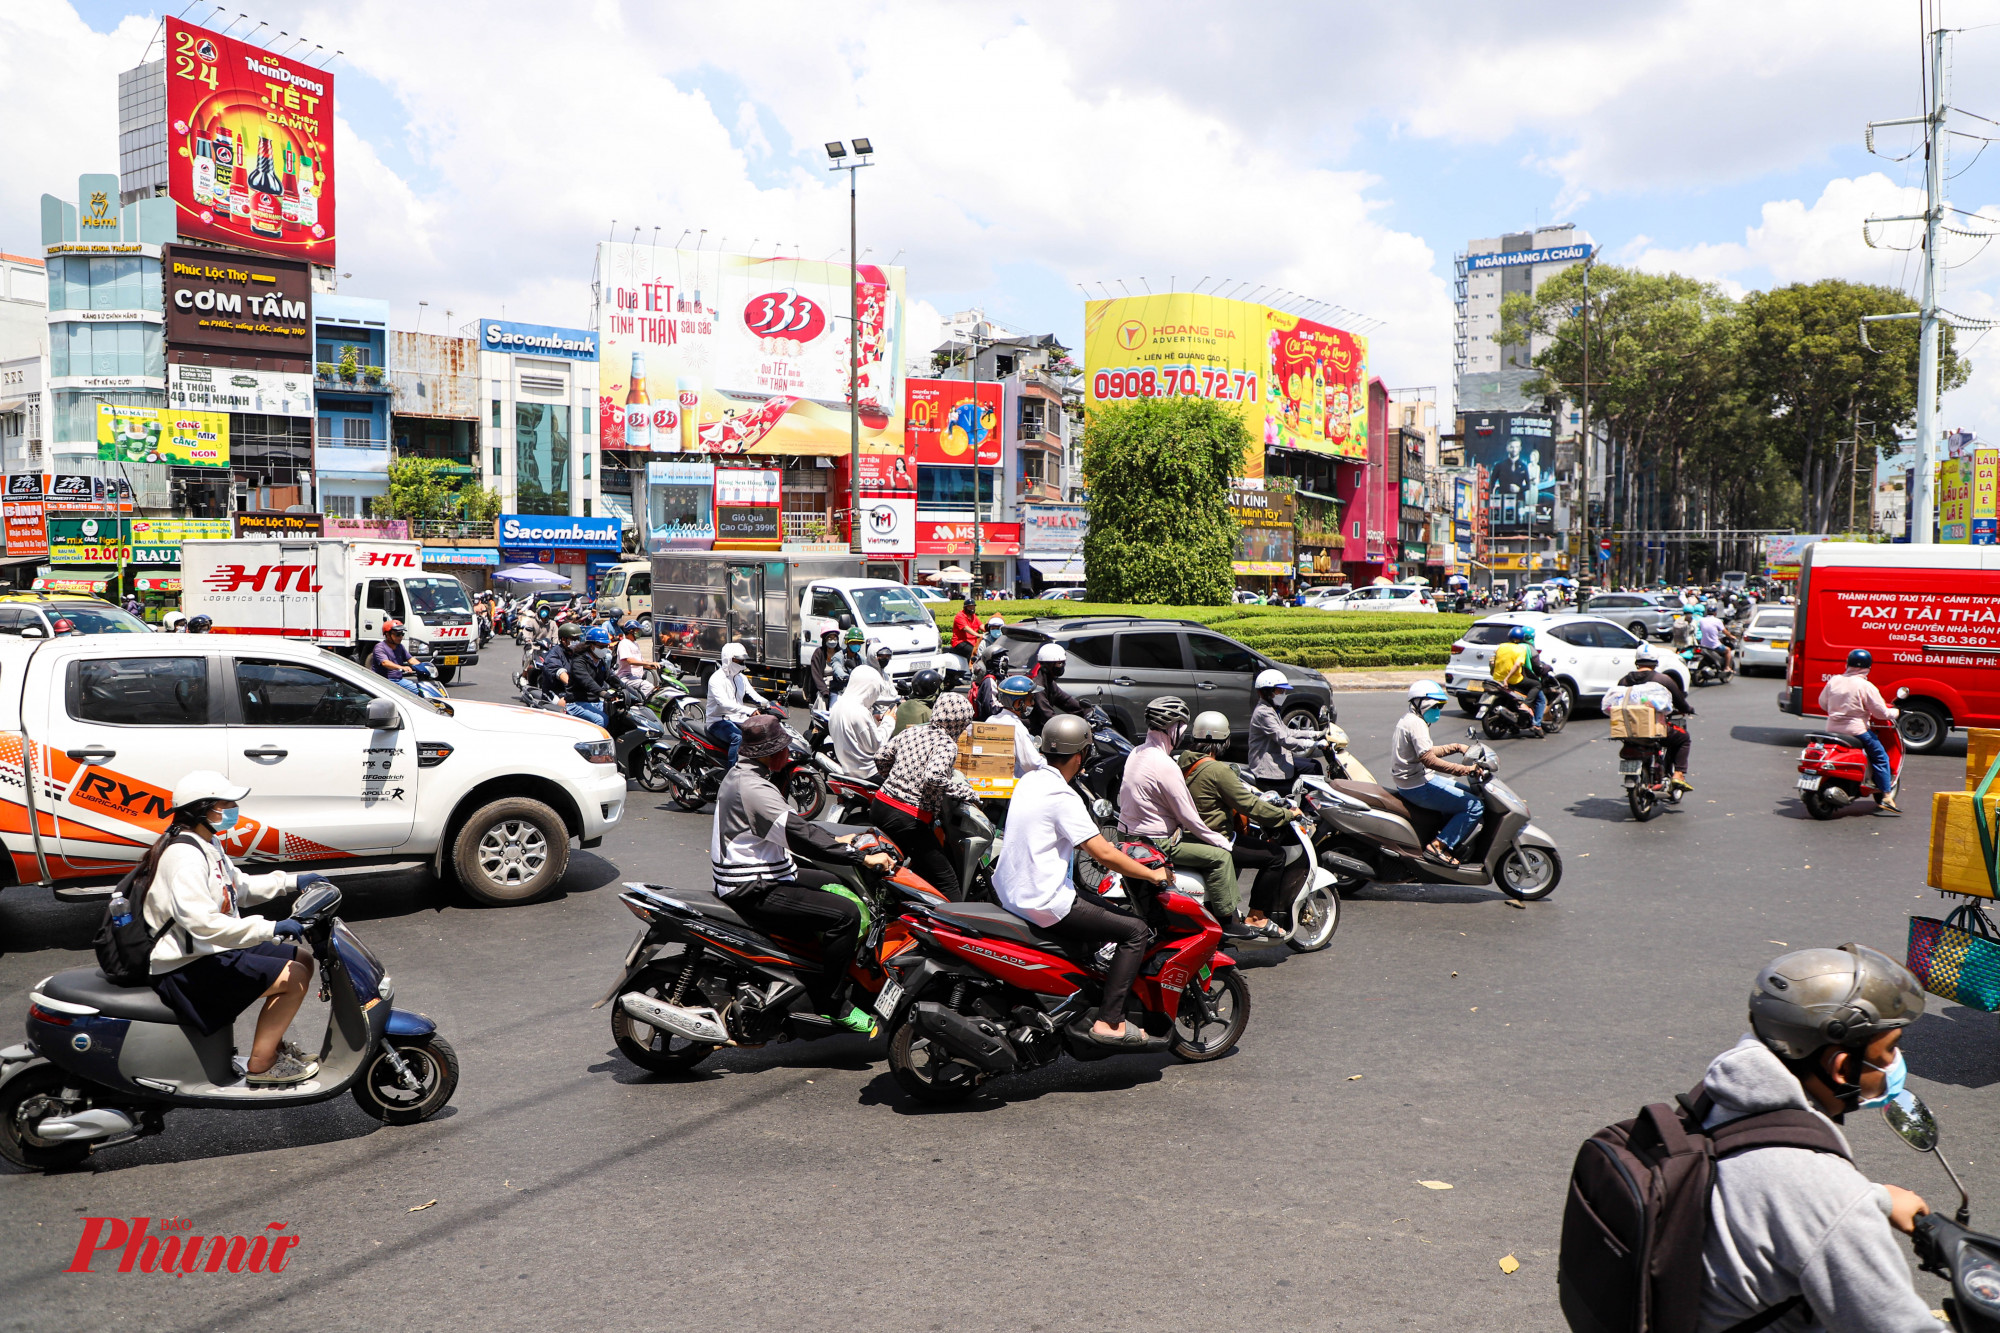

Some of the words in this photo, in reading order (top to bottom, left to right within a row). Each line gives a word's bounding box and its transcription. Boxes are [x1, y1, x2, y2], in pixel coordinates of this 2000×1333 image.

[263, 56, 279, 67] CÓ
[176, 56, 219, 91] 24
[246, 57, 324, 96] NamDương
[265, 83, 319, 115] TẾT
[266, 112, 302, 130] ĐẬM
[304, 122, 319, 137] VỊ
[291, 112, 319, 127] THÊM
[82, 214, 117, 229] Hemi
[75, 245, 89, 253] NHA
[91, 245, 110, 253] KHOA
[1475, 256, 1506, 268] NGÂN
[1508, 251, 1540, 264] HÀNG
[1541, 250, 1550, 260] Á
[1551, 248, 1583, 260] CHÂU
[173, 262, 201, 276] Phúc
[205, 266, 225, 280] Lộc
[227, 269, 246, 284] Thọ
[617, 287, 638, 305] Quà
[642, 277, 674, 313] TẾT
[174, 288, 242, 313] CƠM
[247, 291, 306, 320] TẤM
[751, 287, 812, 334] 333
[210, 319, 233, 329] PHÚC,
[235, 322, 253, 331] uống
[255, 322, 272, 333] LỘC,
[273, 325, 289, 336] sống
[291, 327, 306, 337] THỌ
[610, 315, 634, 337] TÌNH
[638, 317, 677, 346] THÂN
[681, 320, 696, 334] sâu
[697, 318, 712, 334] sắc
[1153, 325, 1210, 336] HOANG
[1214, 328, 1236, 340] GIA
[487, 324, 595, 352] Sacombank
[1153, 337, 1217, 345] ADVERTISING
[1144, 351, 1161, 361] LIÊN
[1163, 352, 1175, 361] HỆ
[1178, 352, 1204, 362] QUẢNG
[1206, 353, 1221, 362] CÁO
[186, 381, 216, 392] THỐNG
[1094, 368, 1257, 403] 0908.70.72.71
[171, 391, 185, 402] 40
[212, 394, 249, 406] NHÁNH
[680, 392, 696, 404] 333
[629, 412, 648, 426] 333
[654, 408, 676, 426] 333
[177, 419, 200, 430] CÀNG
[197, 431, 216, 440] MIX
[191, 450, 217, 458] NGON
[1977, 453, 1996, 465] LẨU
[1979, 470, 1993, 478] GÀ
[1979, 481, 1992, 491] LÁ
[1243, 492, 1268, 508] KÍNH
[4, 502, 42, 516] BÌNH
[1242, 508, 1262, 518] Minh
[240, 516, 264, 527] Phúc
[266, 517, 283, 528] Lộc
[285, 517, 303, 529] Thọ
[338, 519, 359, 528] GIA
[363, 520, 389, 529] HUY
[732, 514, 745, 522] Giỏ
[748, 514, 763, 522] Quà
[504, 520, 618, 541] Sacombank
[737, 522, 753, 532] Cấp
[956, 527, 984, 539] MSB
[66, 537, 83, 545] mix
[84, 548, 130, 560] 12.000
[136, 550, 171, 562] RAU
[363, 552, 416, 567] HTL
[208, 565, 323, 593] HTL
[1837, 592, 1867, 600] THÀNH
[1871, 593, 1896, 602] HƯNG
[1899, 594, 1918, 602] TAXI
[1921, 594, 1935, 602] TẢI
[1847, 606, 1898, 618] TAXI
[1904, 605, 1941, 620] TẢI
[1948, 607, 2000, 622] THÀ
[437, 627, 468, 637] HTL
[1888, 622, 1902, 632] VỤ
[1925, 652, 1944, 664] ĐÀI
[75, 791, 139, 817] LUBRICANTS
